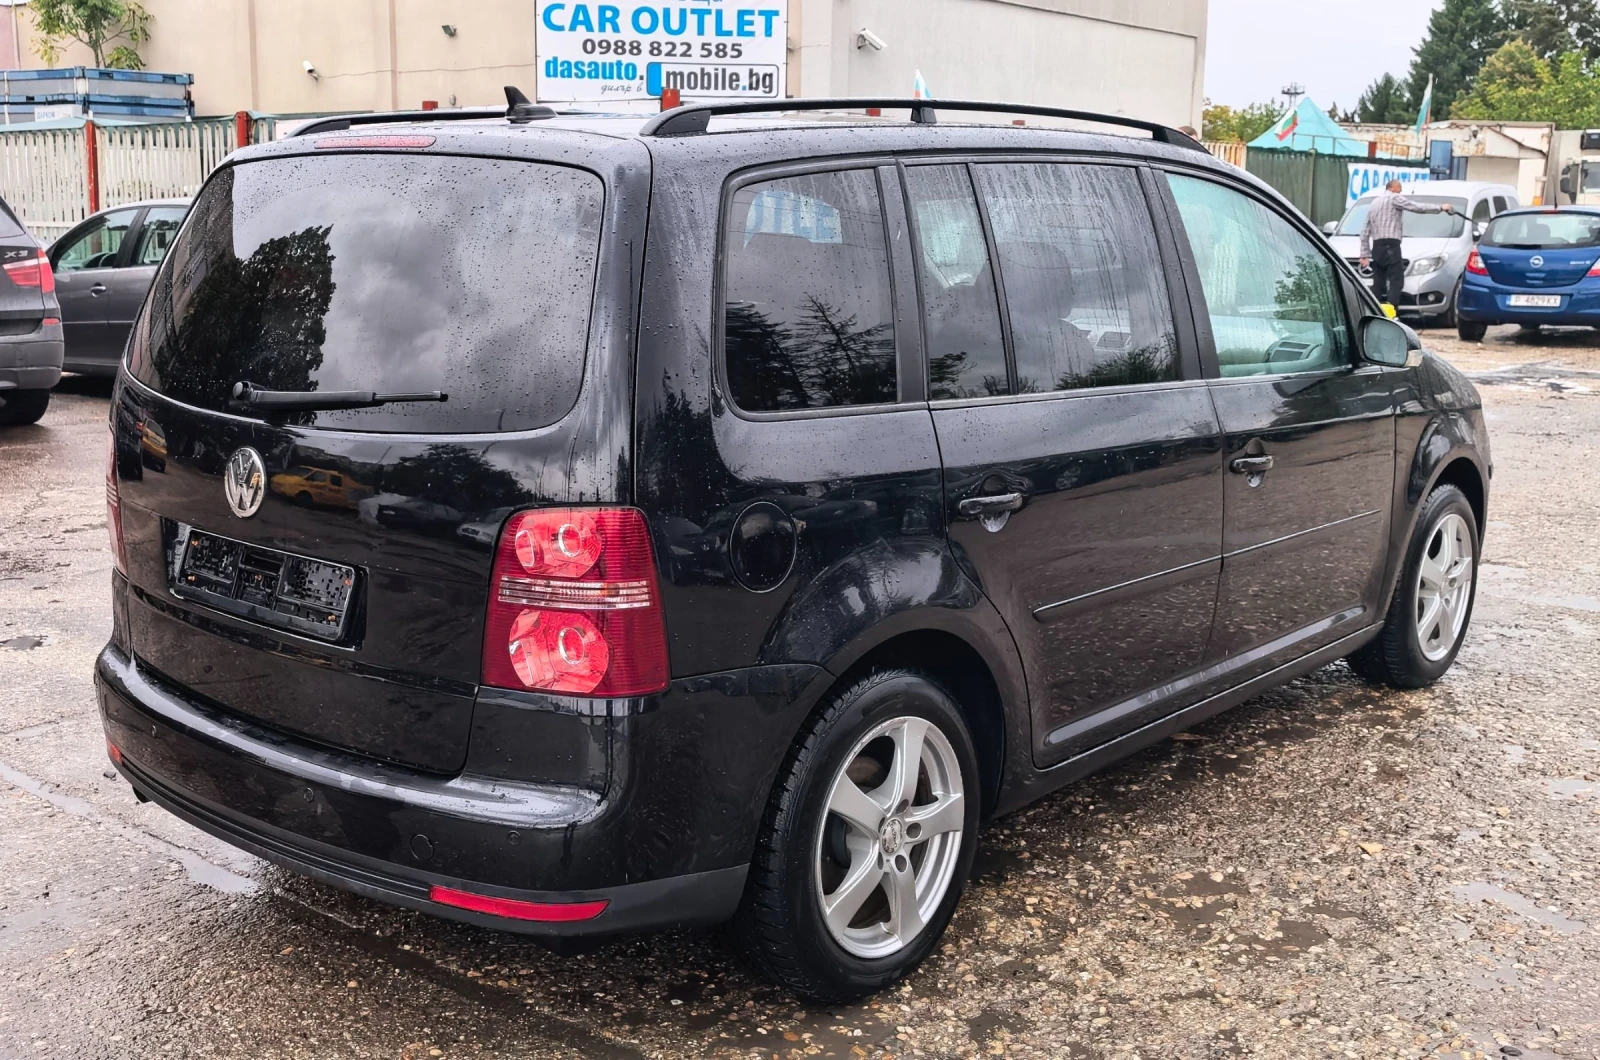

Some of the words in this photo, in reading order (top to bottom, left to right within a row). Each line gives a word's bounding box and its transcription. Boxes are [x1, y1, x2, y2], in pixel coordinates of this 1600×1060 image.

[542, 3, 621, 34] CAR
[631, 6, 780, 38] OUTLET
[582, 38, 643, 56] 0988
[648, 41, 693, 58] 822
[700, 42, 743, 59] 585
[665, 65, 774, 94] mobile.bg
[4, 250, 28, 258] X3
